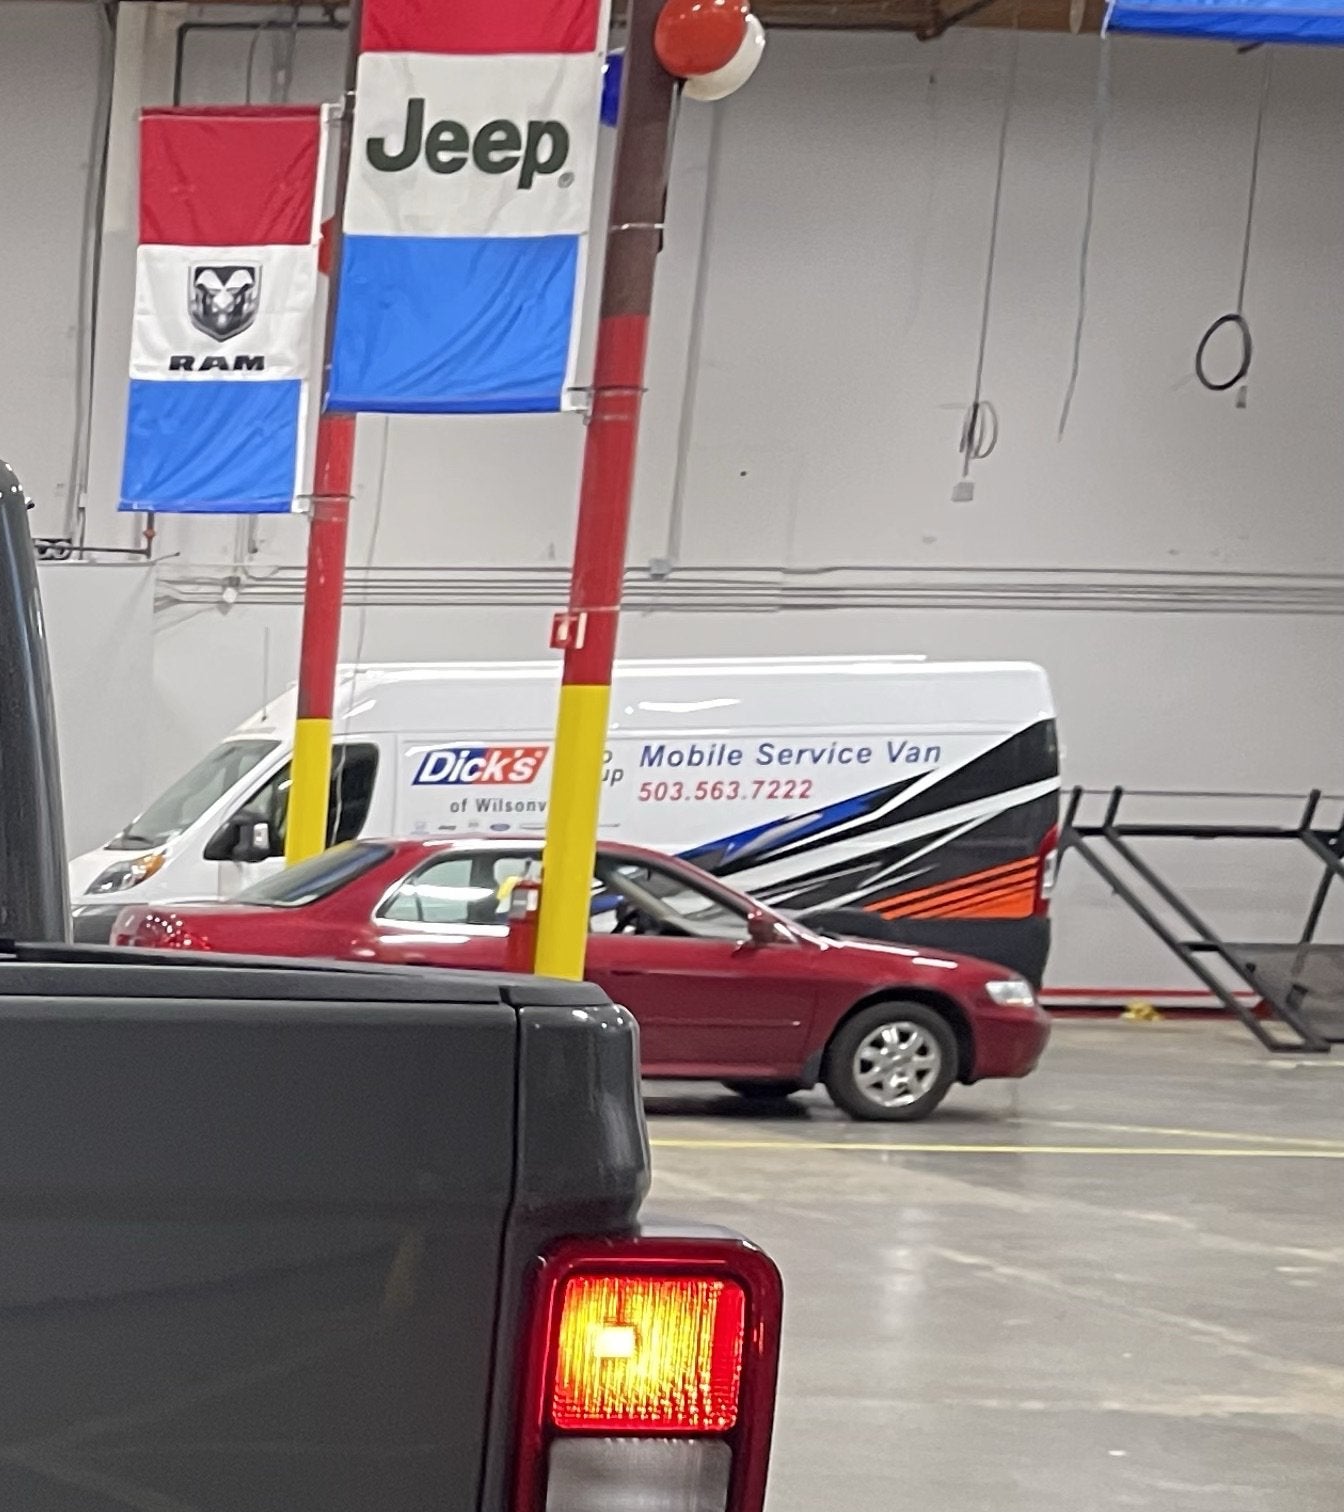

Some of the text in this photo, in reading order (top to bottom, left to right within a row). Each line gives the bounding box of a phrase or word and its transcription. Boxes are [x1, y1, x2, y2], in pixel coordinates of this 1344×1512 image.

[366, 98, 570, 190] Jeep
[168, 355, 265, 371] RAM
[639, 740, 942, 768] Mobile Service Van
[638, 779, 814, 801] 503.563.7222
[450, 799, 547, 813] of Wilsonv
